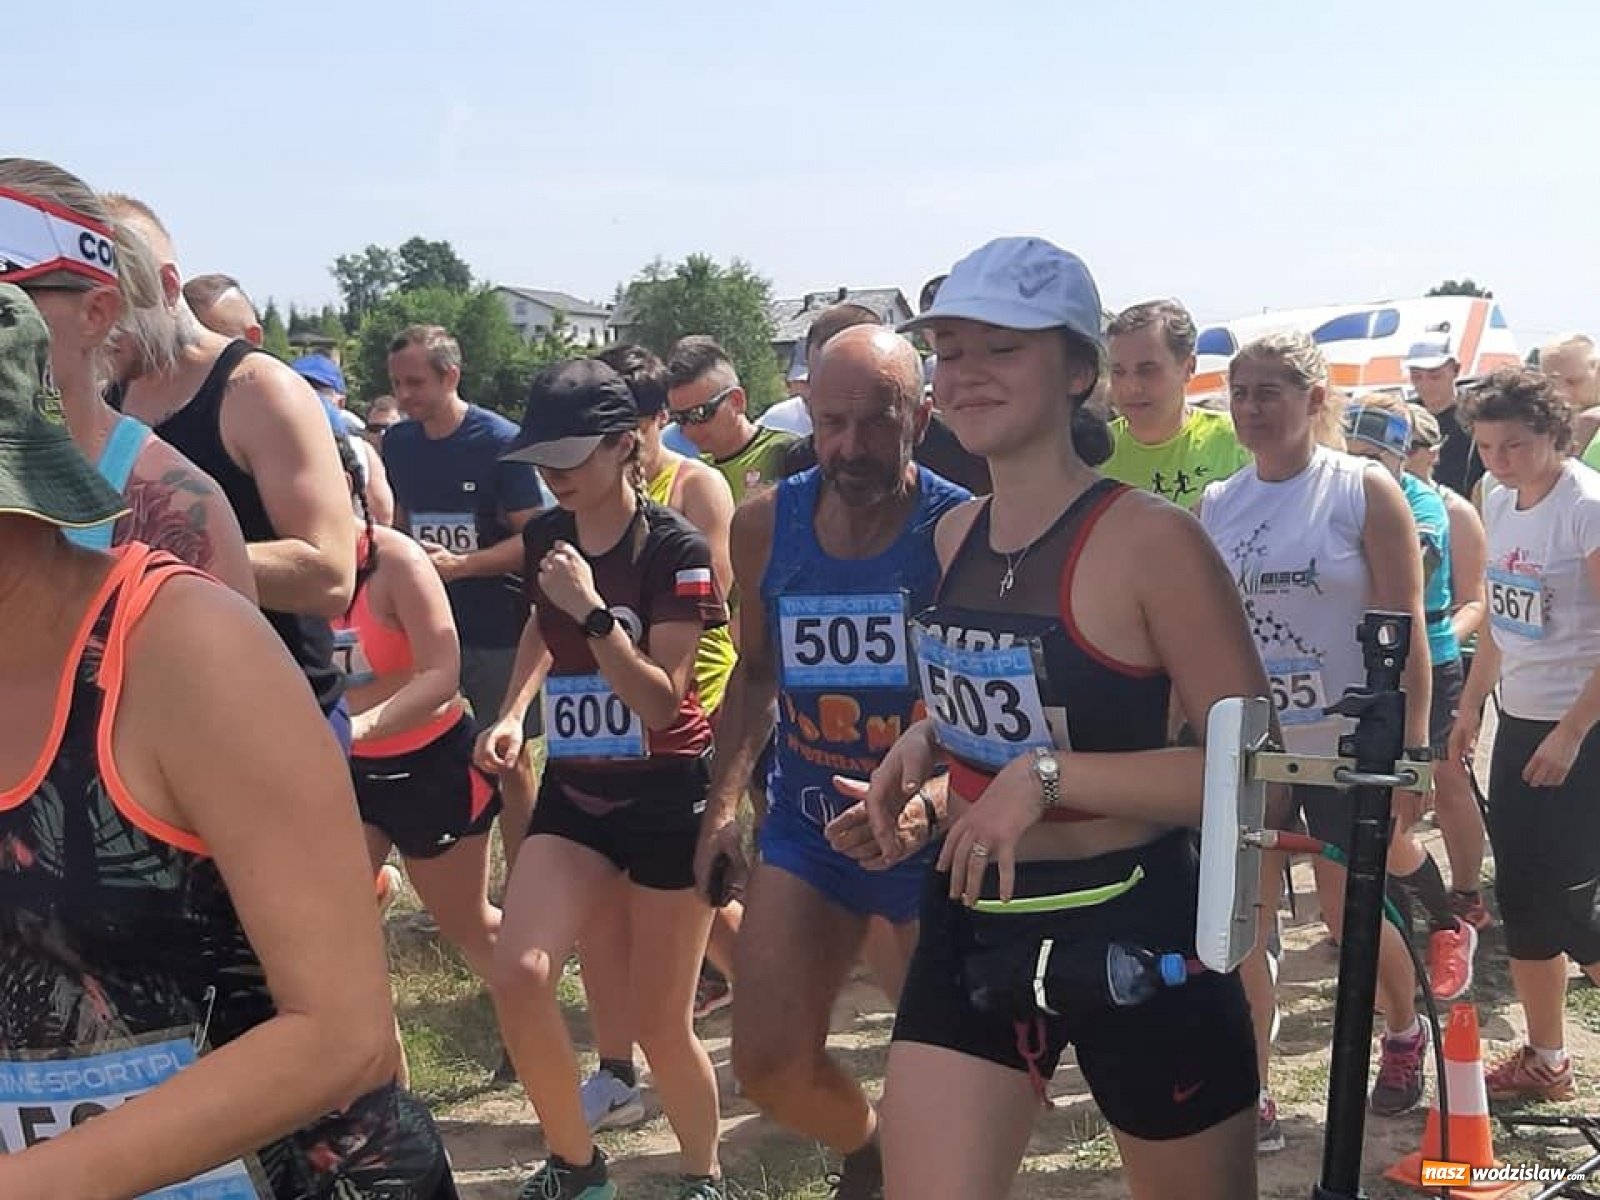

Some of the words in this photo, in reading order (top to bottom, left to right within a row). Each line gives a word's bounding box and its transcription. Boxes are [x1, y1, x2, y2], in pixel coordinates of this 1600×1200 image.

[79, 231, 117, 271] CO
[419, 524, 470, 549] 506
[1493, 584, 1534, 623] 567
[794, 616, 895, 666] 505
[928, 664, 1031, 742] 503
[1269, 674, 1316, 711] 65
[554, 694, 631, 738] 600
